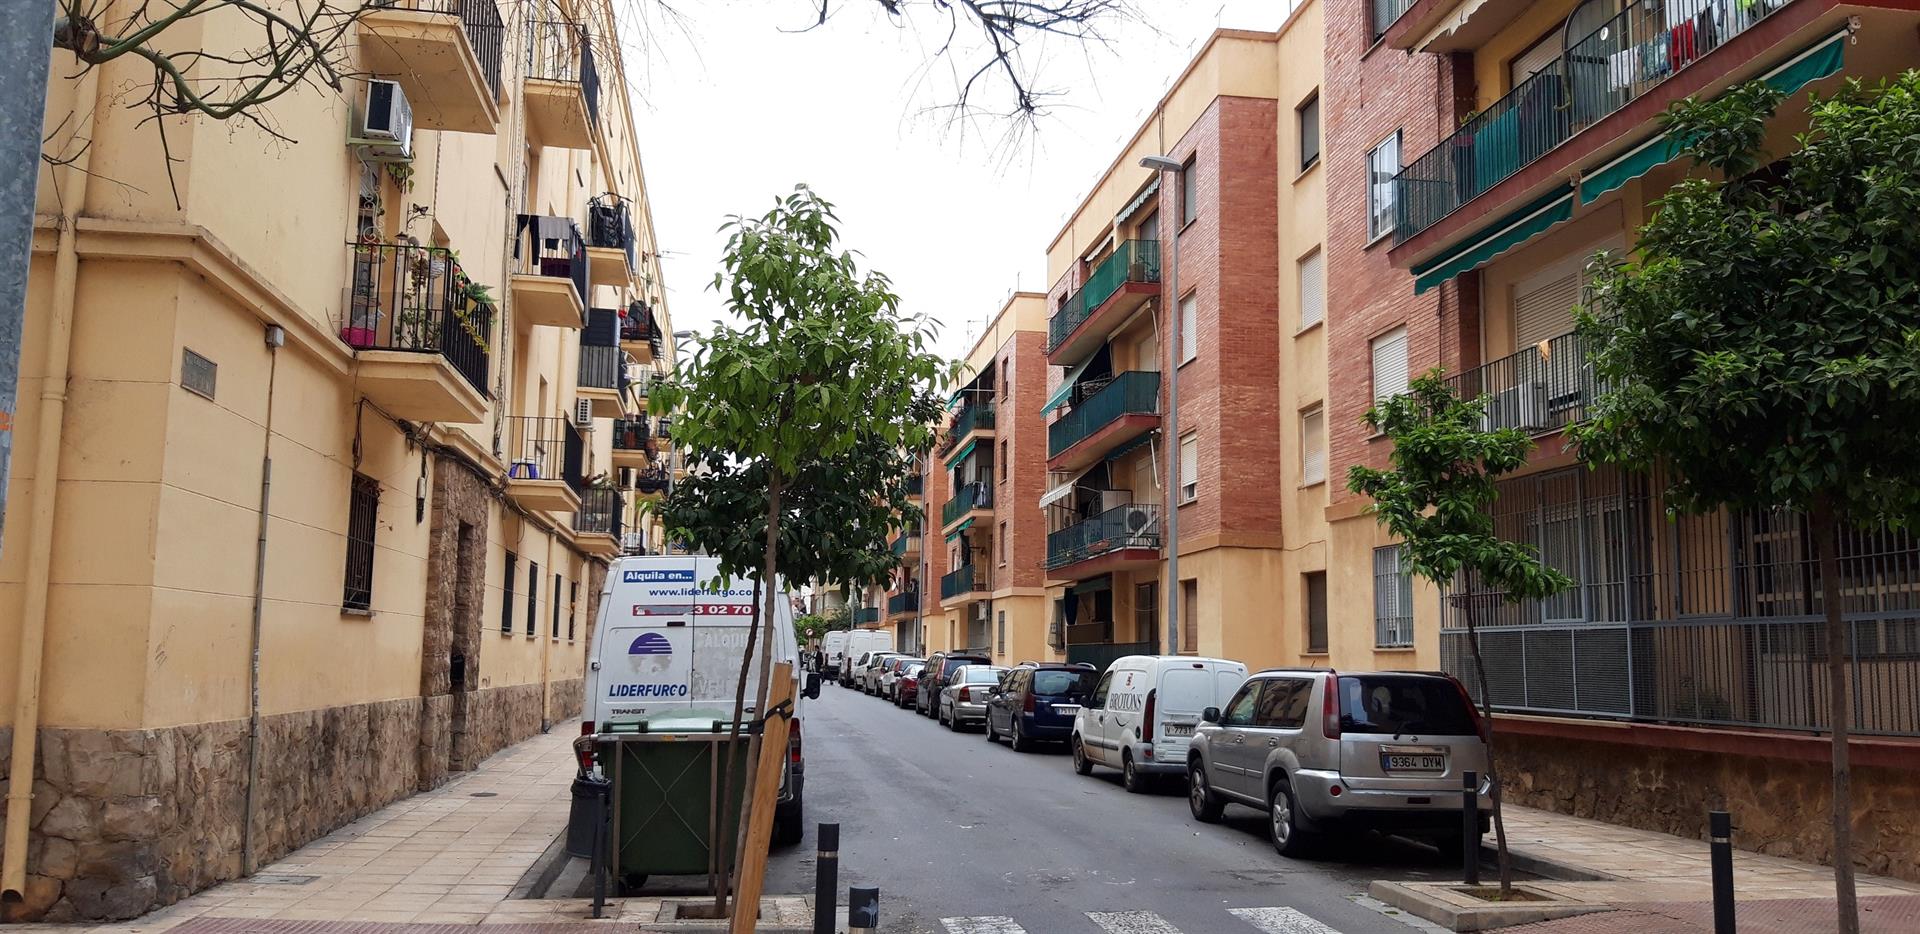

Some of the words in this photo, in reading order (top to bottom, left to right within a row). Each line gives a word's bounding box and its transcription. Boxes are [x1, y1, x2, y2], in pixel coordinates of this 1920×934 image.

[626, 572, 665, 581] Alquila
[709, 606, 727, 614] 02
[733, 606, 752, 614] 70
[1391, 757, 1417, 768] 9364
[1422, 756, 1442, 768] DYM
